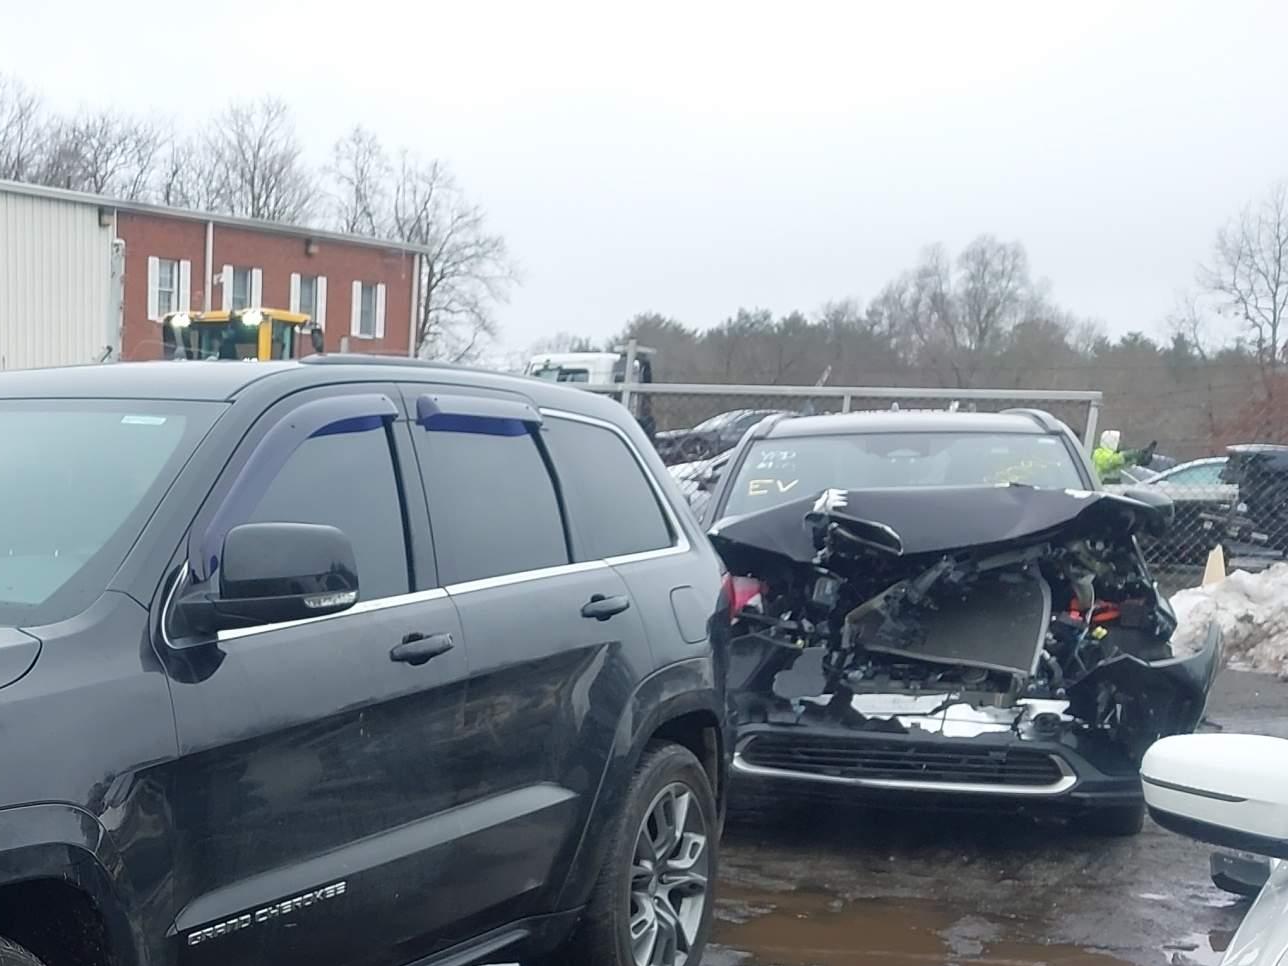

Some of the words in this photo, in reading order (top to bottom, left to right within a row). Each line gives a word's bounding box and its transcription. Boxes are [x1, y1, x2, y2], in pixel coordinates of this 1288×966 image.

[749, 479, 799, 495] EV
[188, 914, 251, 946] GRAND
[255, 881, 347, 922] CHEROKEE
